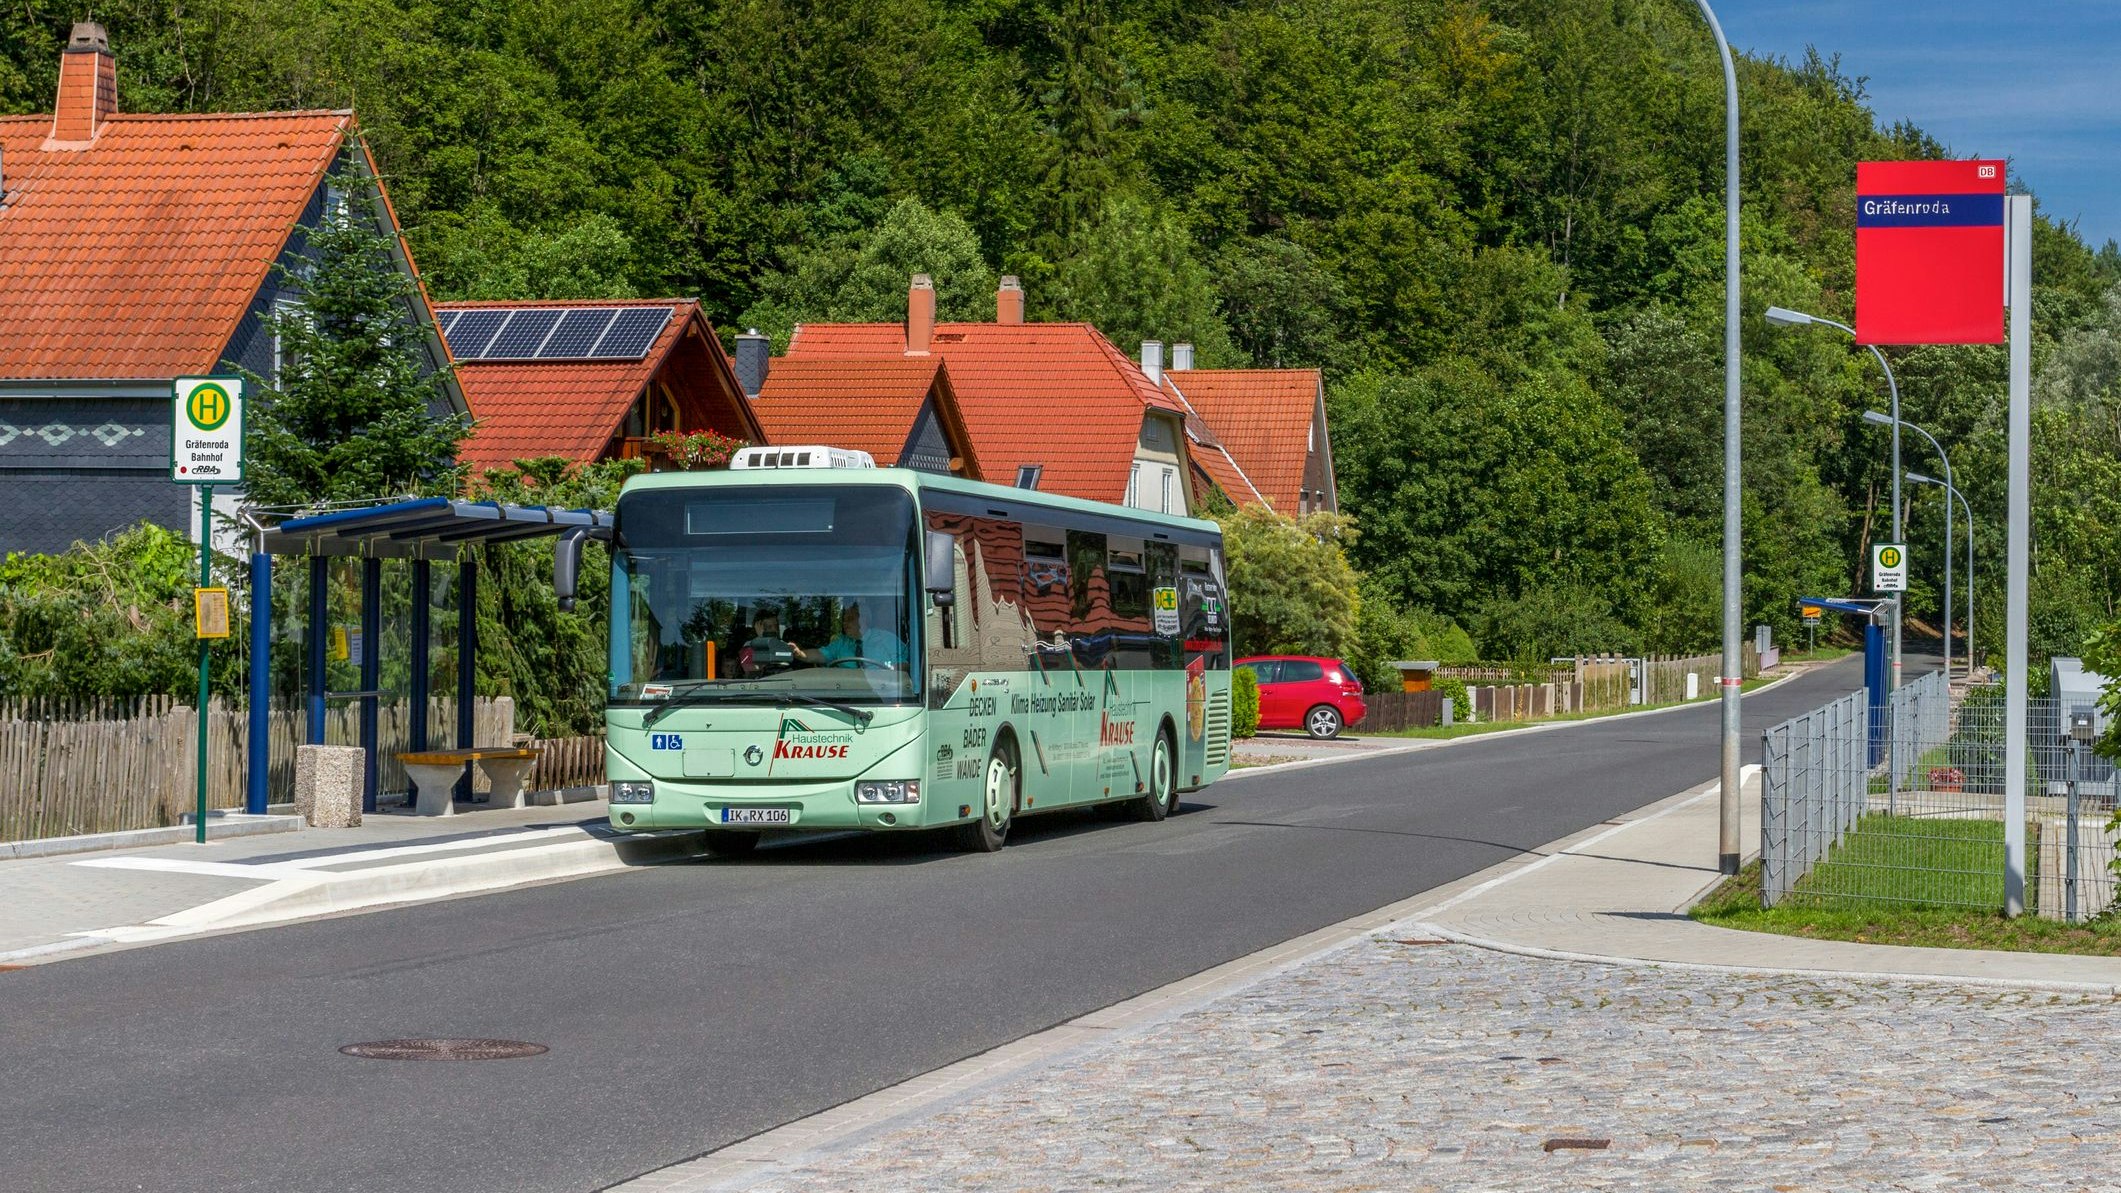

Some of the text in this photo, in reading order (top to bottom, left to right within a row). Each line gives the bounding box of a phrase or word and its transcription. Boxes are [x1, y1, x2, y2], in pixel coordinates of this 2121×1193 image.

[1980, 168, 1994, 177] DB
[1864, 200, 1950, 215] Gräfenroda
[199, 394, 217, 420] H
[185, 439, 229, 449] Gräfenroda
[191, 452, 223, 462] Bahnhof
[196, 465, 216, 474] RBA
[1886, 552, 1894, 564] H
[969, 696, 997, 717] DECKEN
[1011, 691, 1096, 718] Klima Heizung Sanitär Solar
[963, 723, 987, 749] BÄDER
[1100, 711, 1135, 747] KRAUSE
[792, 733, 854, 744] Haustechnik
[774, 739, 850, 759] KRAUSE
[956, 755, 982, 780] WÄNDE
[729, 810, 787, 821] IK RX 106
